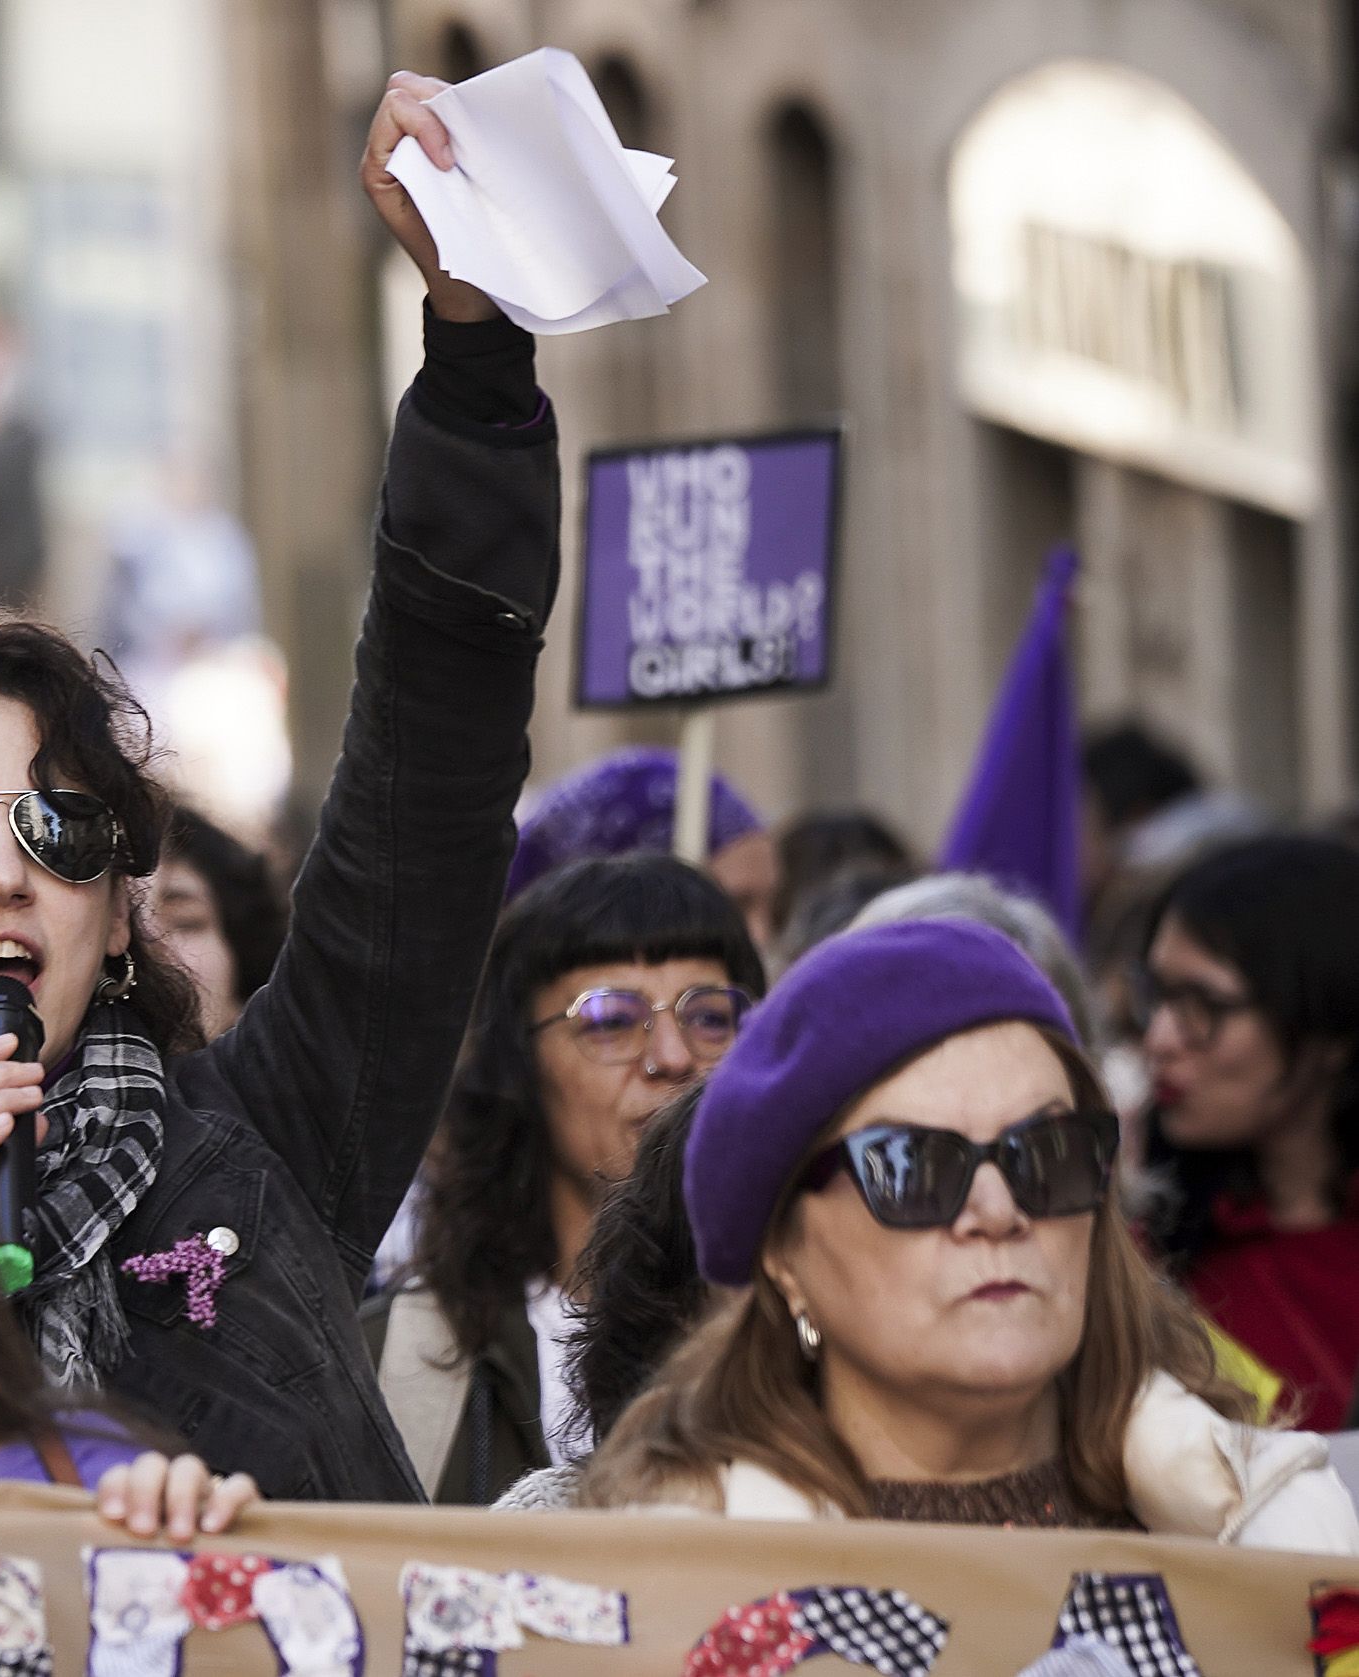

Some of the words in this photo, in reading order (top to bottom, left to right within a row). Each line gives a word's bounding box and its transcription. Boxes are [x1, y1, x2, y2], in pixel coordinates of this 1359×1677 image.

[629, 448, 748, 497] WHO
[630, 496, 748, 545] RUN
[630, 543, 744, 593] THE
